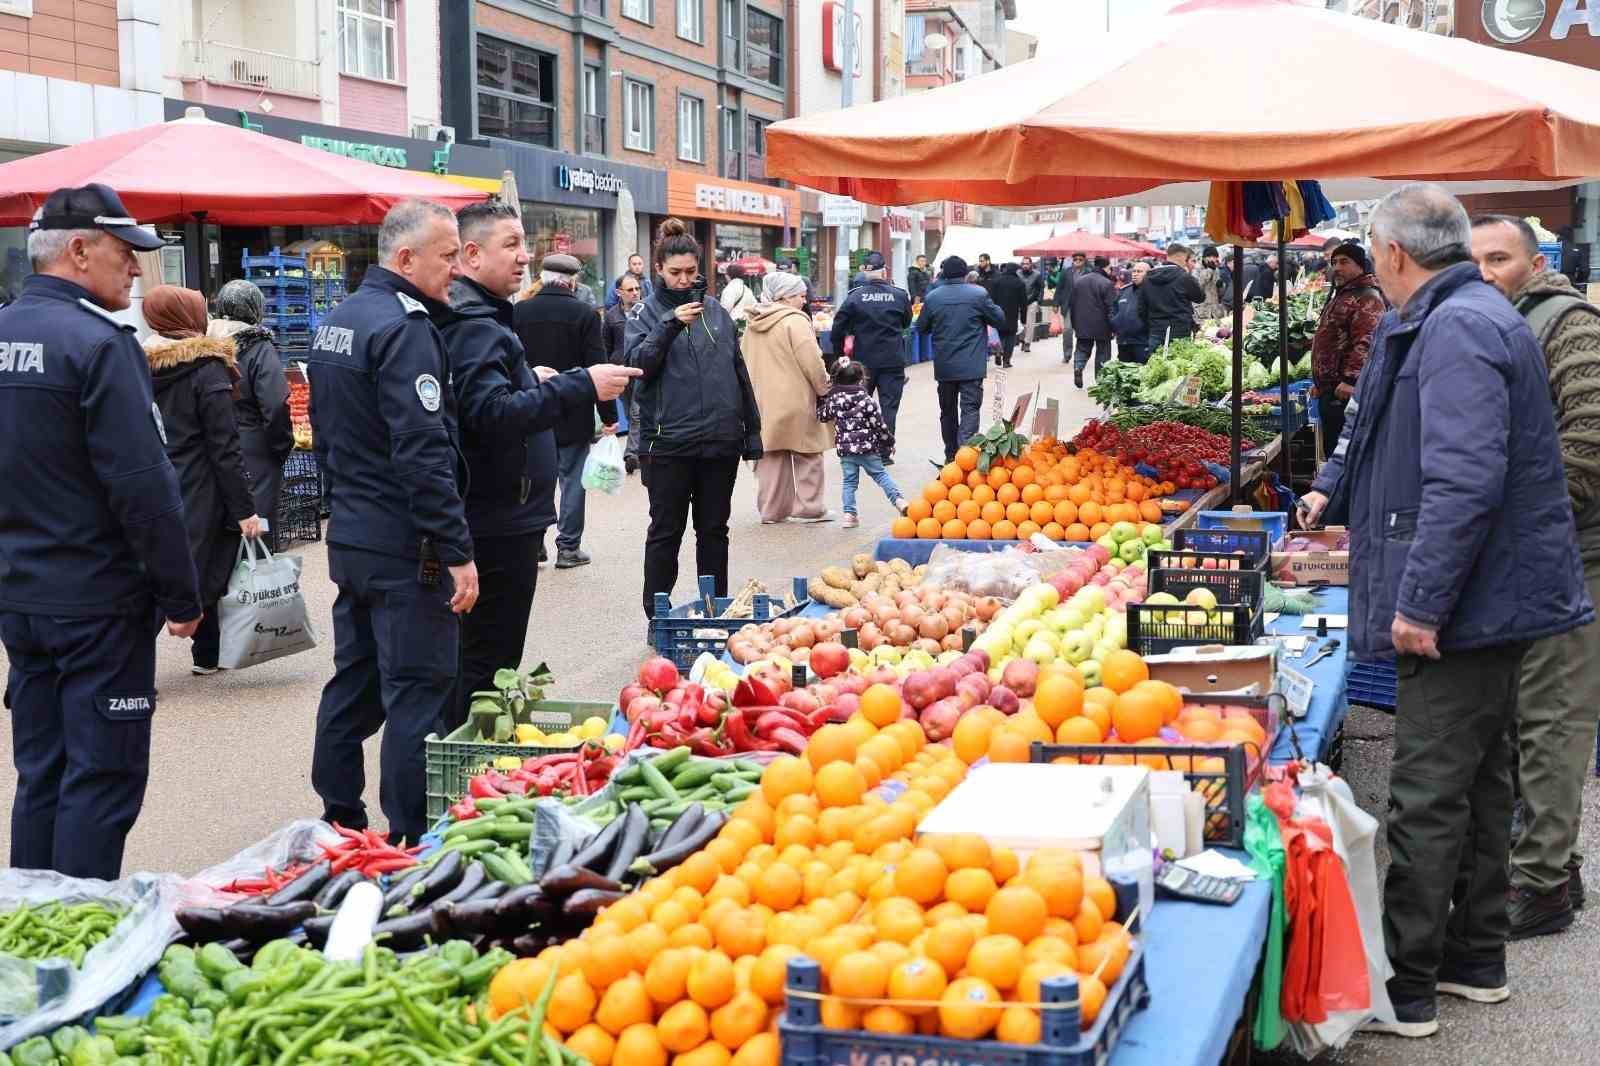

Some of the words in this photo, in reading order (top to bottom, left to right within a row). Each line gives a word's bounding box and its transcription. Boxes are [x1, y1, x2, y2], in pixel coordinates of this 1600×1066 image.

[695, 183, 726, 211] EFE
[861, 292, 895, 302] ZABITA
[109, 696, 150, 711] ZABITA
